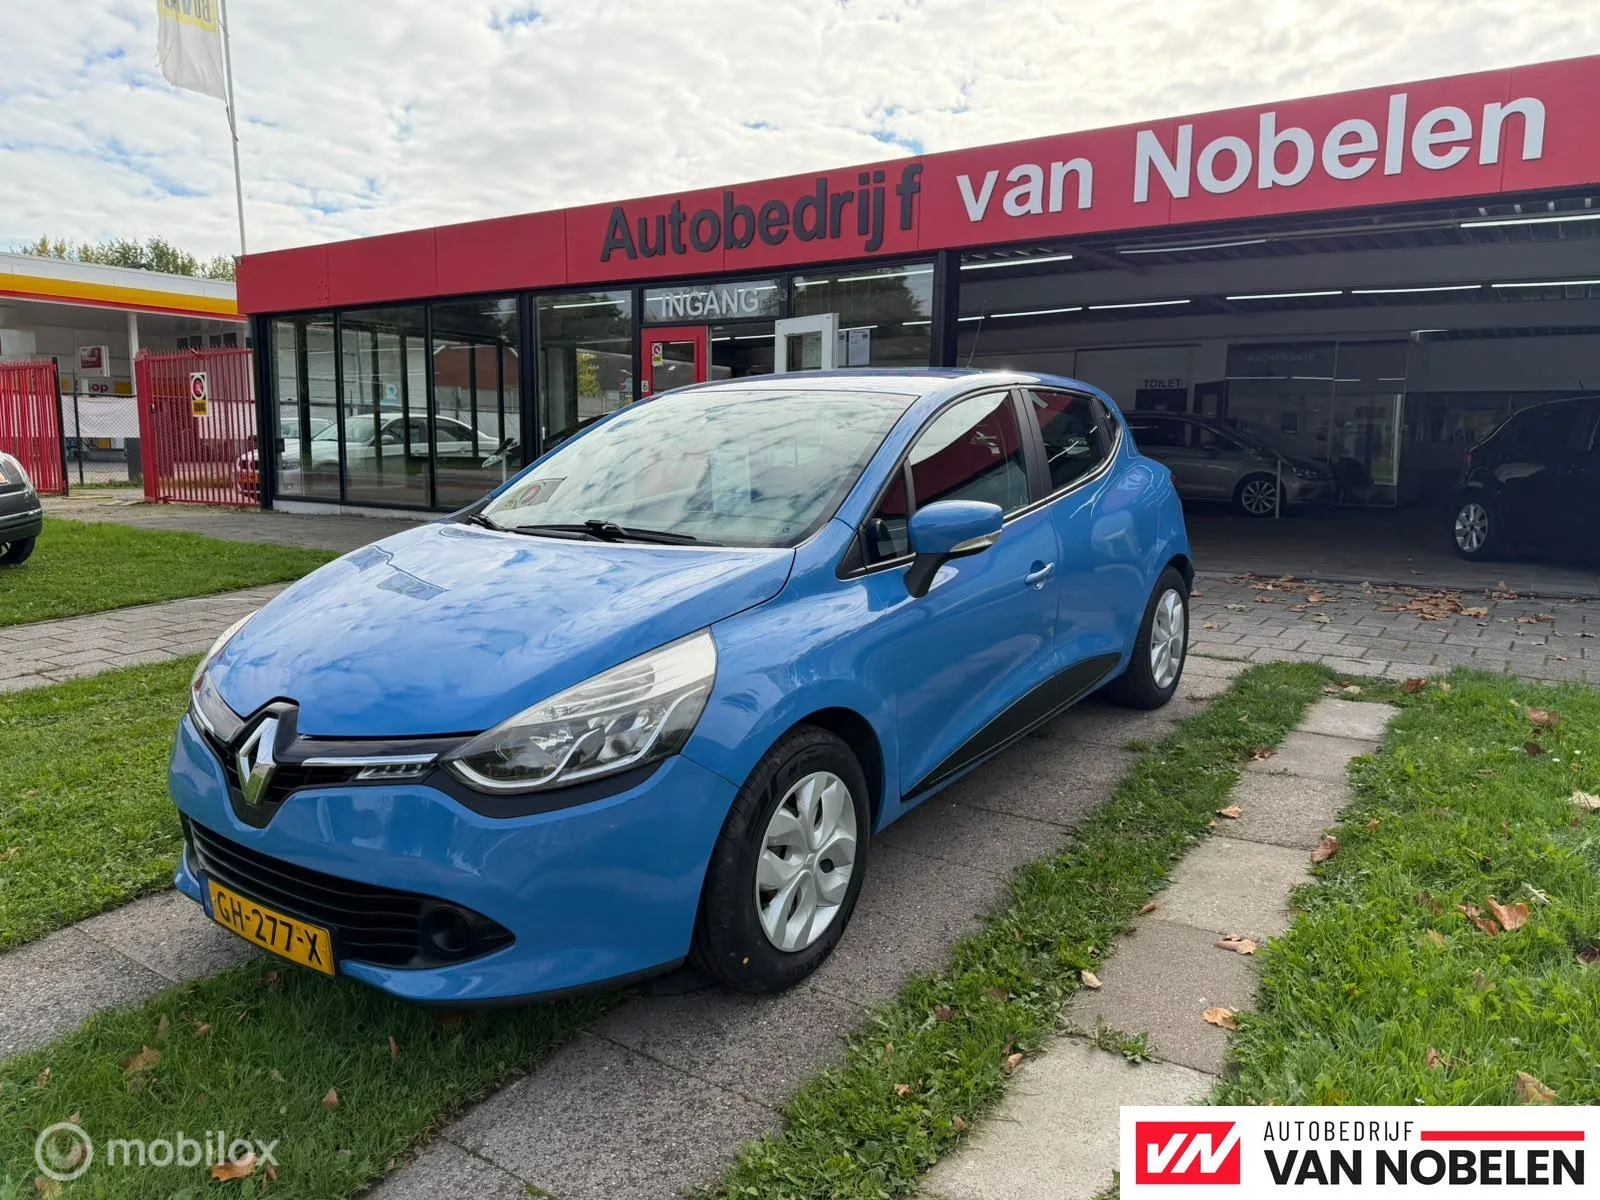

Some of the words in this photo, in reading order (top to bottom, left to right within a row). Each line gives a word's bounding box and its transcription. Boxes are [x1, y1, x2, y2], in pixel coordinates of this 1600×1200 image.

[600, 163, 923, 262] Autobedrijf
[956, 157, 1094, 222] van
[1133, 93, 1547, 203] Nobelen
[662, 287, 759, 317] INGANG
[1143, 378, 1182, 388] TOILET
[217, 890, 322, 966] GH-277-X
